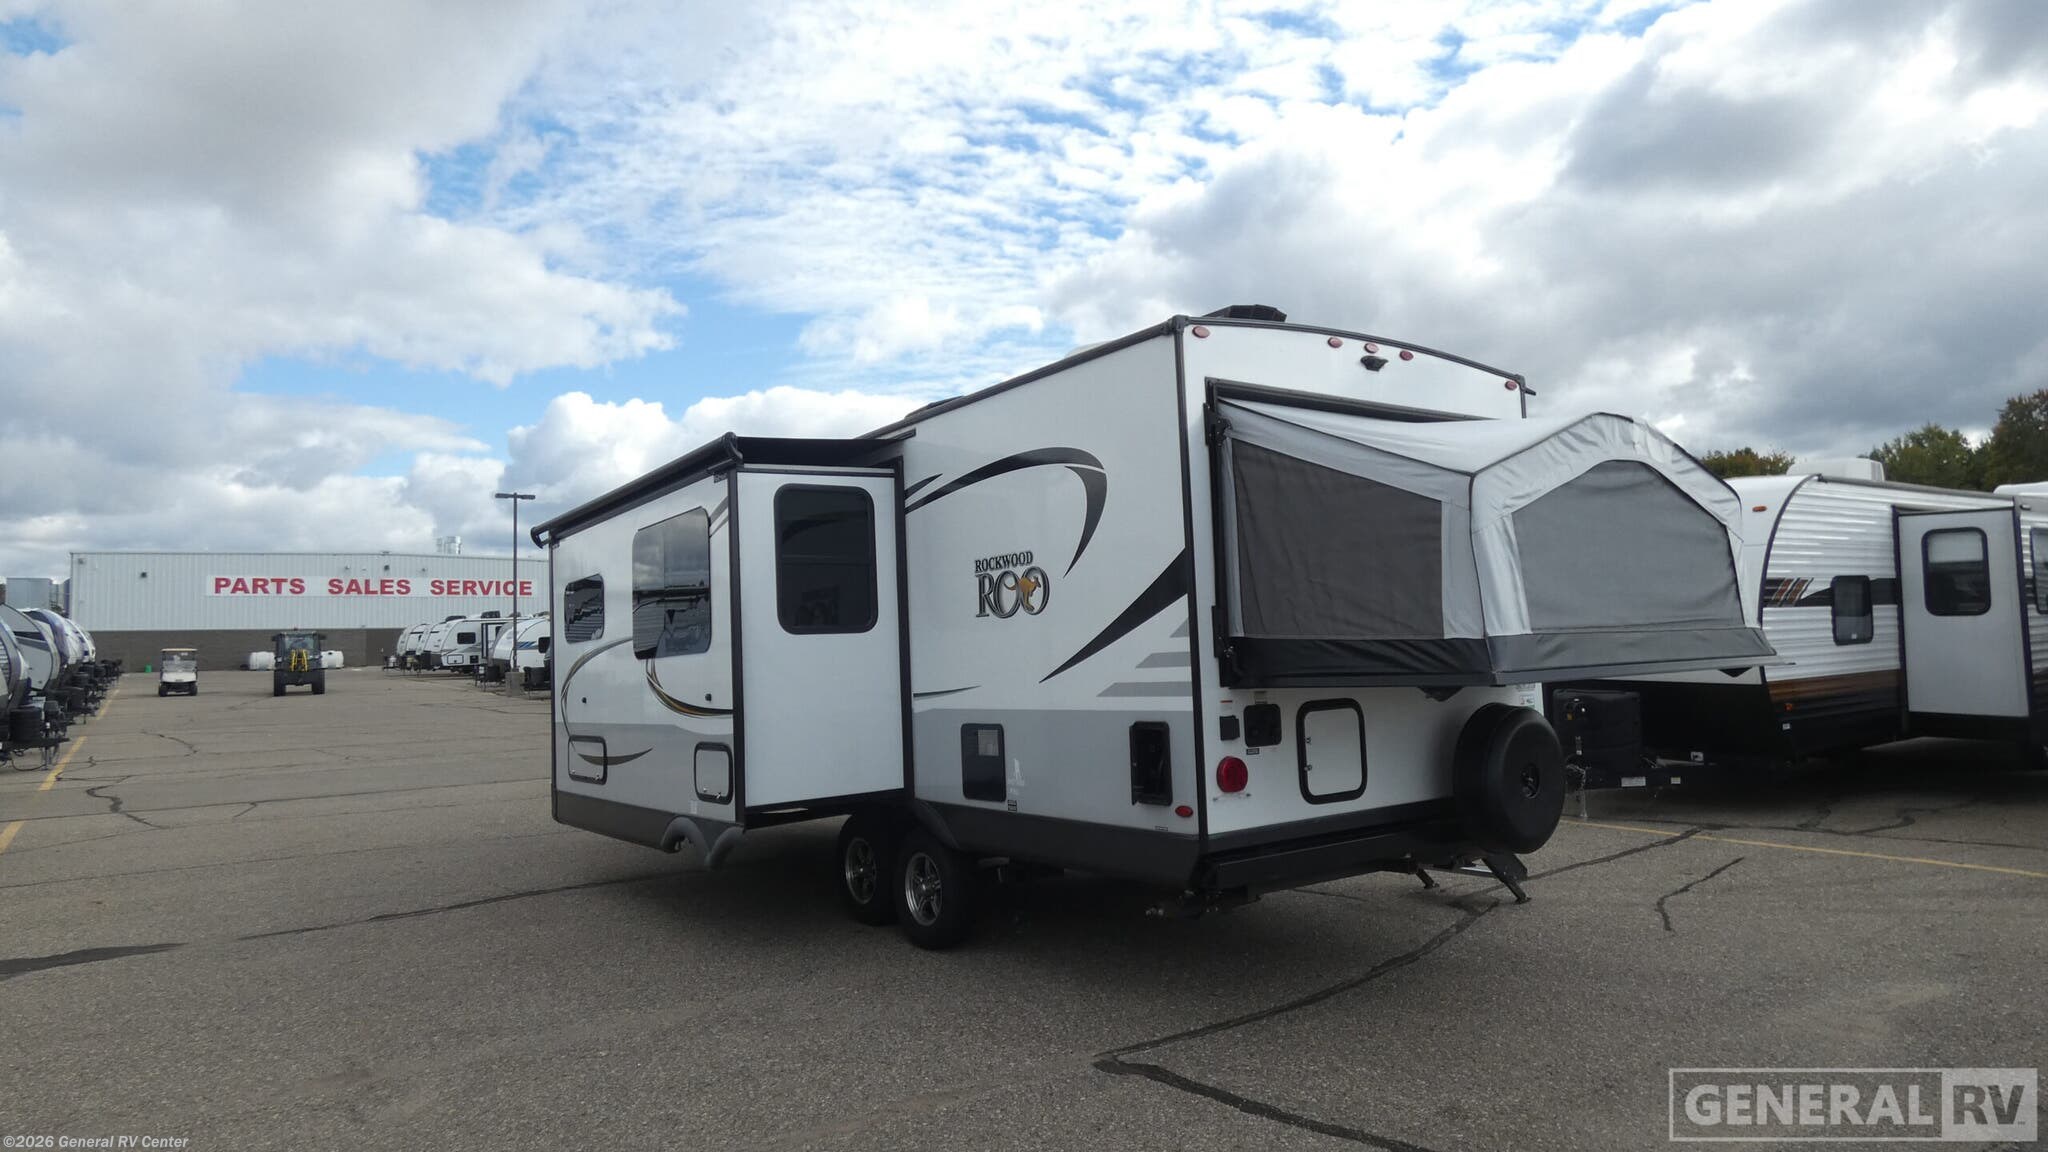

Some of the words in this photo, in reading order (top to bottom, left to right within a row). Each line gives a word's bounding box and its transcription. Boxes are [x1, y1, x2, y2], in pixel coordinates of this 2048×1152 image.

[975, 551, 1033, 573] ROCKWOOD
[214, 577, 306, 594] PARTS
[328, 578, 412, 595] SALES
[430, 580, 533, 596] SERVICE
[975, 566, 1050, 619] ROO
